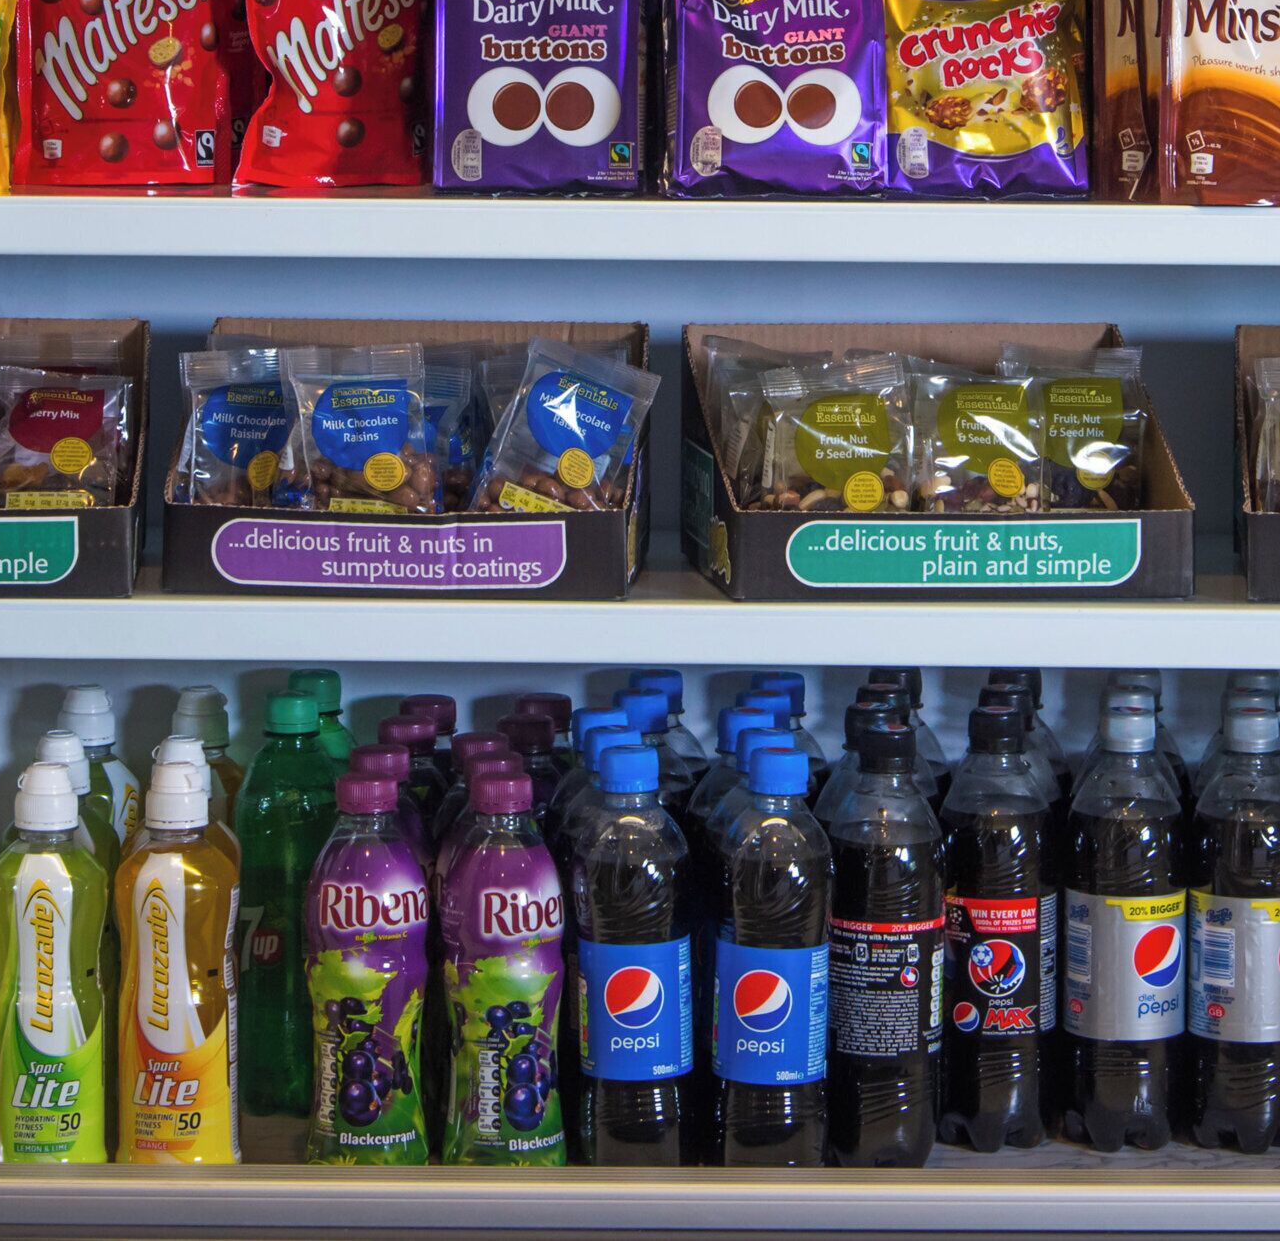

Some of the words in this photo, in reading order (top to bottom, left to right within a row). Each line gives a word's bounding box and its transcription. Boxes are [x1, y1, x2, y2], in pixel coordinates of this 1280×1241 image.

[548, 24, 608, 37] GIANT
[480, 34, 607, 62] buttons
[721, 33, 845, 66] buttons
[1193, 55, 1233, 67] Pleasure
[1235, 61, 1266, 76] worth
[322, 418, 345, 430] Milk
[348, 414, 399, 429] Chocolate
[343, 430, 379, 444] Raisins
[229, 529, 341, 553] ...delicious
[347, 531, 392, 554] fruit
[398, 534, 412, 554] &
[420, 534, 466, 554] nuts
[473, 535, 493, 553] in
[808, 530, 926, 552] ...delicious
[934, 530, 979, 552] fruit
[987, 532, 1002, 551] &
[1009, 532, 1064, 554] nuts,
[321, 559, 445, 581] sumptuous
[451, 557, 542, 583] coatings
[922, 555, 979, 581] plain
[986, 555, 1028, 576] and
[1036, 554, 1111, 580] simple
[319, 883, 430, 930] Ribena
[971, 908, 987, 918] WIN
[990, 908, 1019, 918] EVERY
[1021, 908, 1036, 918] DAY
[1150, 902, 1179, 915] BIGGER
[892, 924, 907, 932] 20%
[908, 921, 934, 931] BIGGER
[252, 933, 279, 960] up
[29, 903, 54, 1034] Lucozade
[146, 902, 169, 1031] Lucozade
[1138, 994, 1155, 1002] diet
[1138, 995, 1179, 1018] pepsi
[983, 1005, 1037, 1030] MAX
[611, 1033, 660, 1053] pepsi
[736, 1038, 785, 1056] pepsi
[28, 1060, 64, 1075] Sport
[12, 1073, 80, 1109] Lite
[59, 1112, 81, 1131] 50
[135, 1120, 162, 1129] FITNESS
[136, 1112, 173, 1122] HYDRATING
[178, 1111, 201, 1131] 50
[135, 1128, 154, 1137] DRINK
[339, 1128, 417, 1147] Blackcurrant
[138, 1141, 168, 1150] ORANGE
